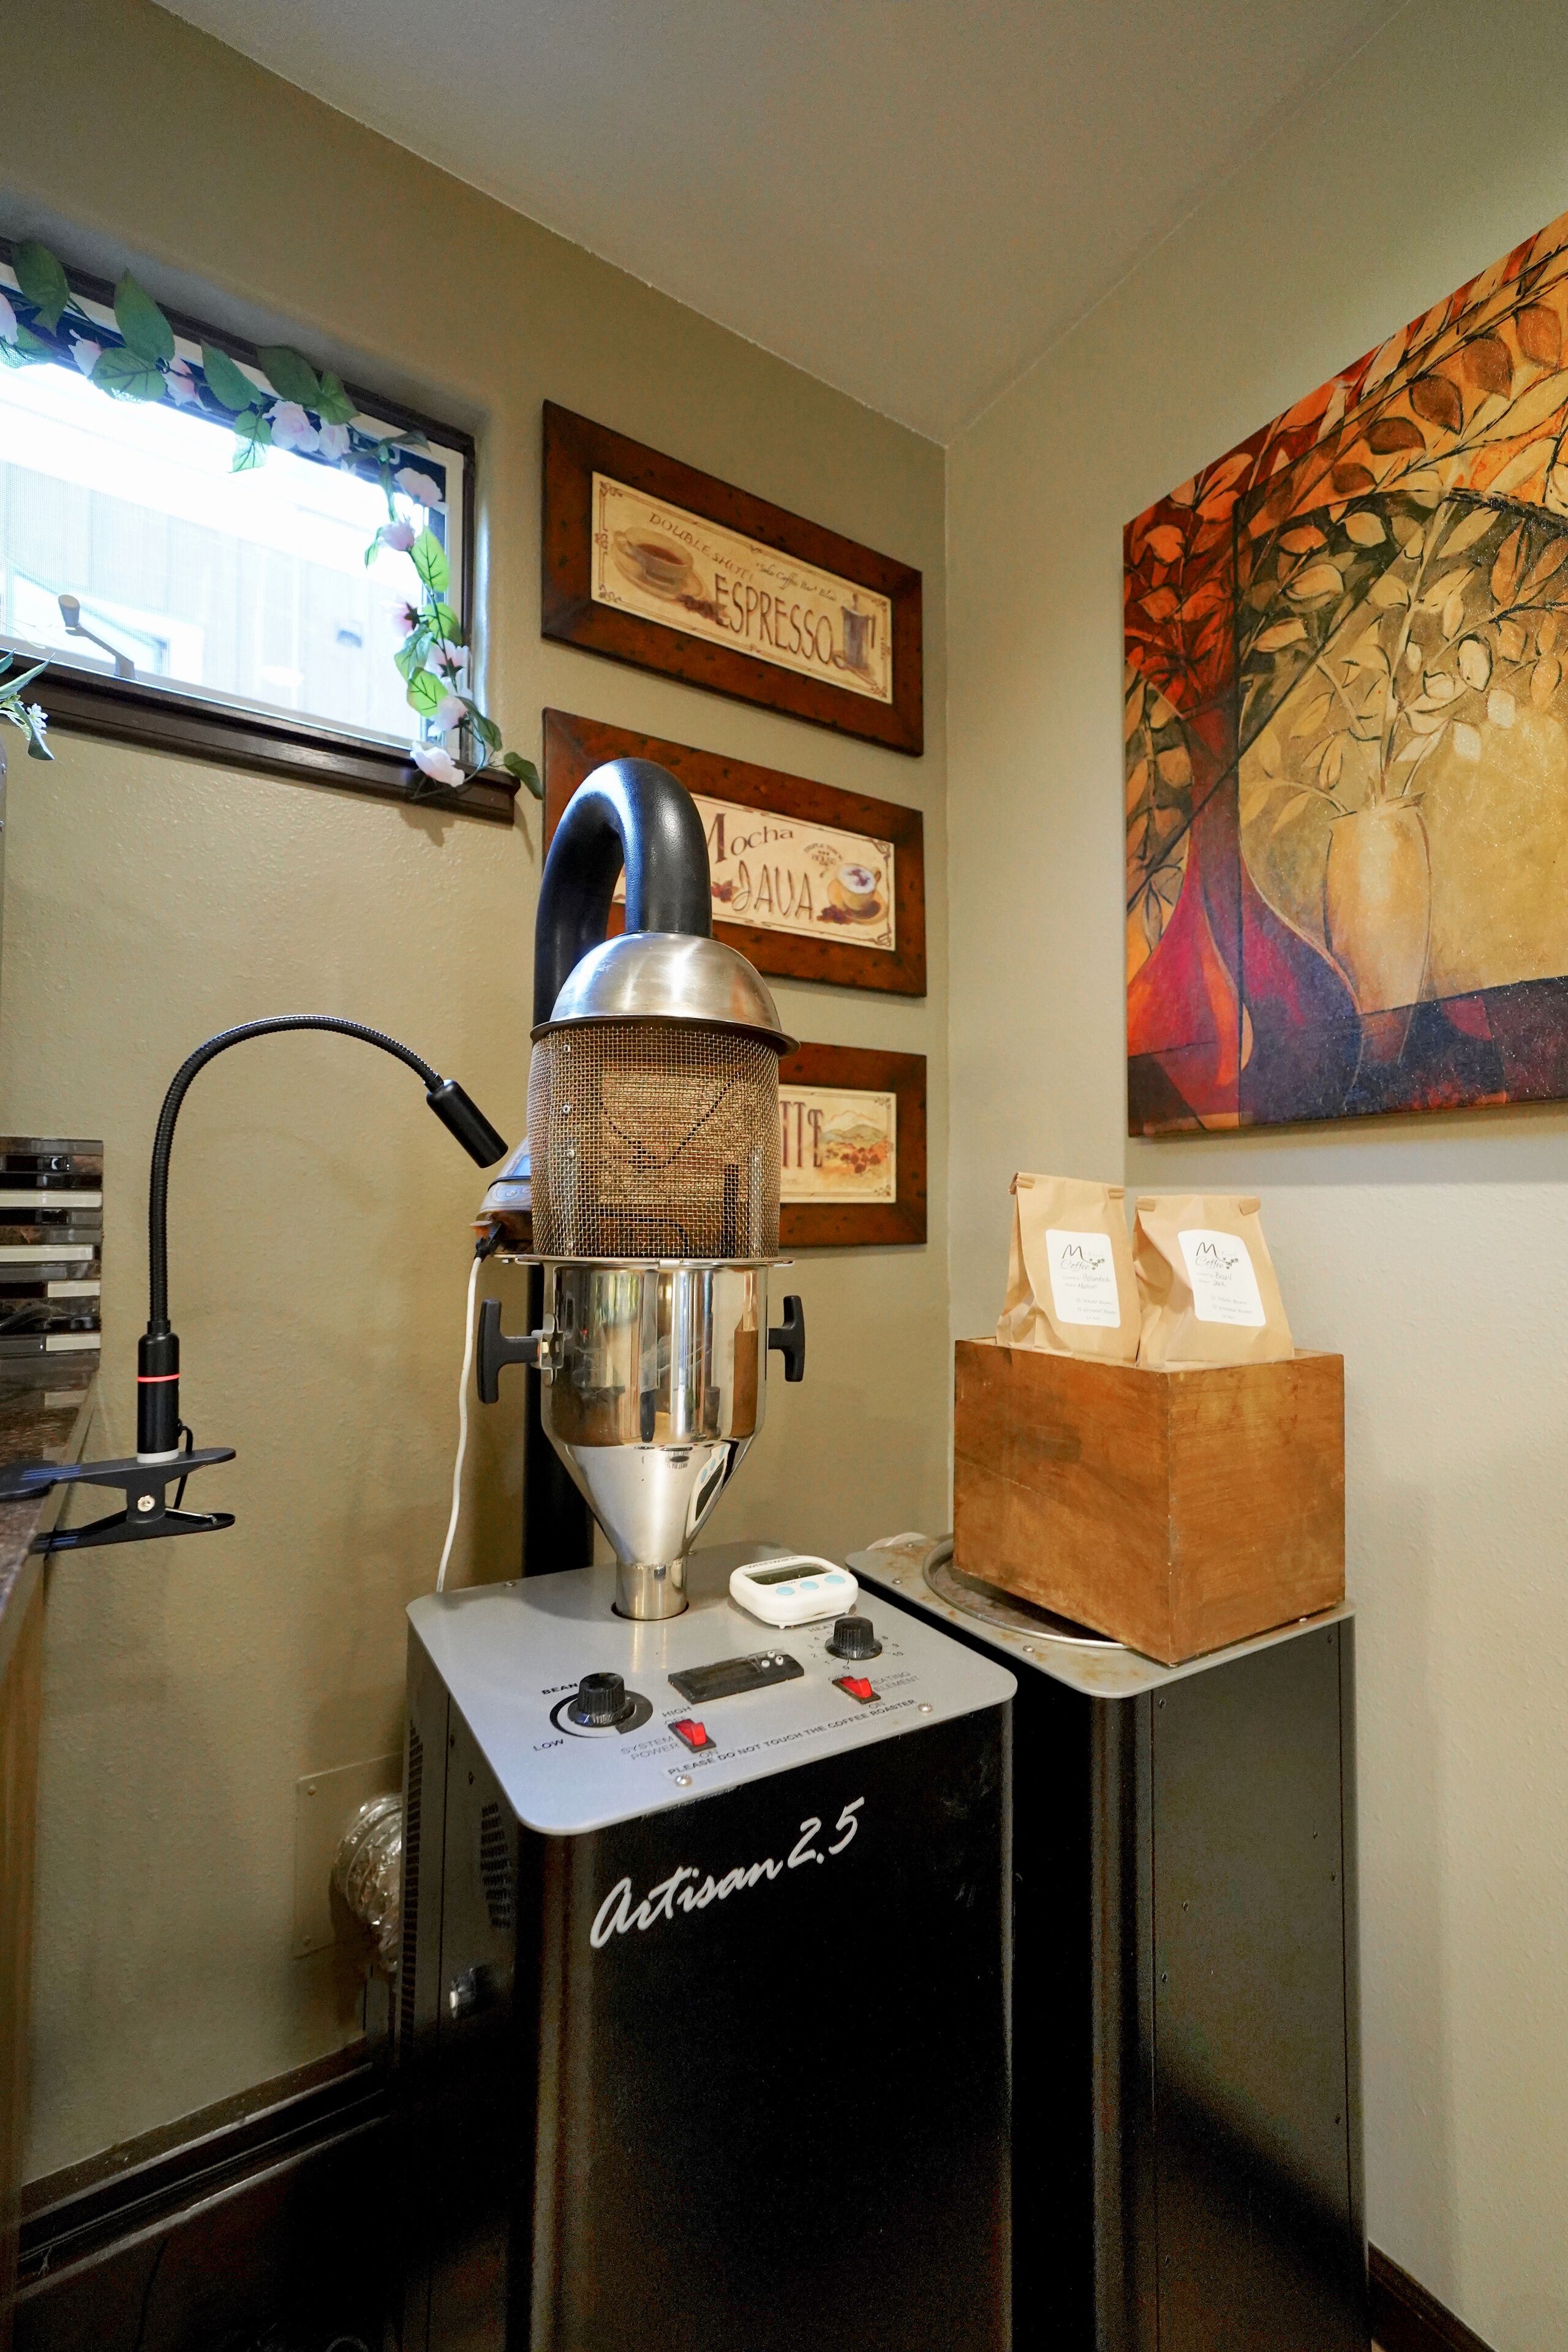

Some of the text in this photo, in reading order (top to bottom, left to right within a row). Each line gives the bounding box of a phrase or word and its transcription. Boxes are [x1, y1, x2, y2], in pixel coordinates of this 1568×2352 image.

[649, 513, 710, 556] DOUBLE
[715, 573, 833, 664] ESPRESSO
[731, 860, 813, 920] JAVA
[779, 1101, 824, 1167] TTE
[1060, 1259, 1090, 1272] Coffee
[1195, 1256, 1223, 1269] Coffee
[541, 1683, 578, 1695] BEAN
[874, 1676, 919, 1692] ELEMENT
[662, 1706, 692, 1717] HIGH
[533, 1738, 564, 1751] LOW
[620, 1736, 674, 1754] SYSTEM
[668, 1758, 715, 1774] PLEASE
[738, 1743, 761, 1755] NOT
[764, 1732, 804, 1747] TOUCH
[805, 1724, 827, 1735] THE
[827, 1713, 869, 1728] COFFEE
[870, 1699, 916, 1716] ROASTER
[631, 1743, 681, 1760] POWER
[590, 1796, 865, 1948] Artisan 2.5
